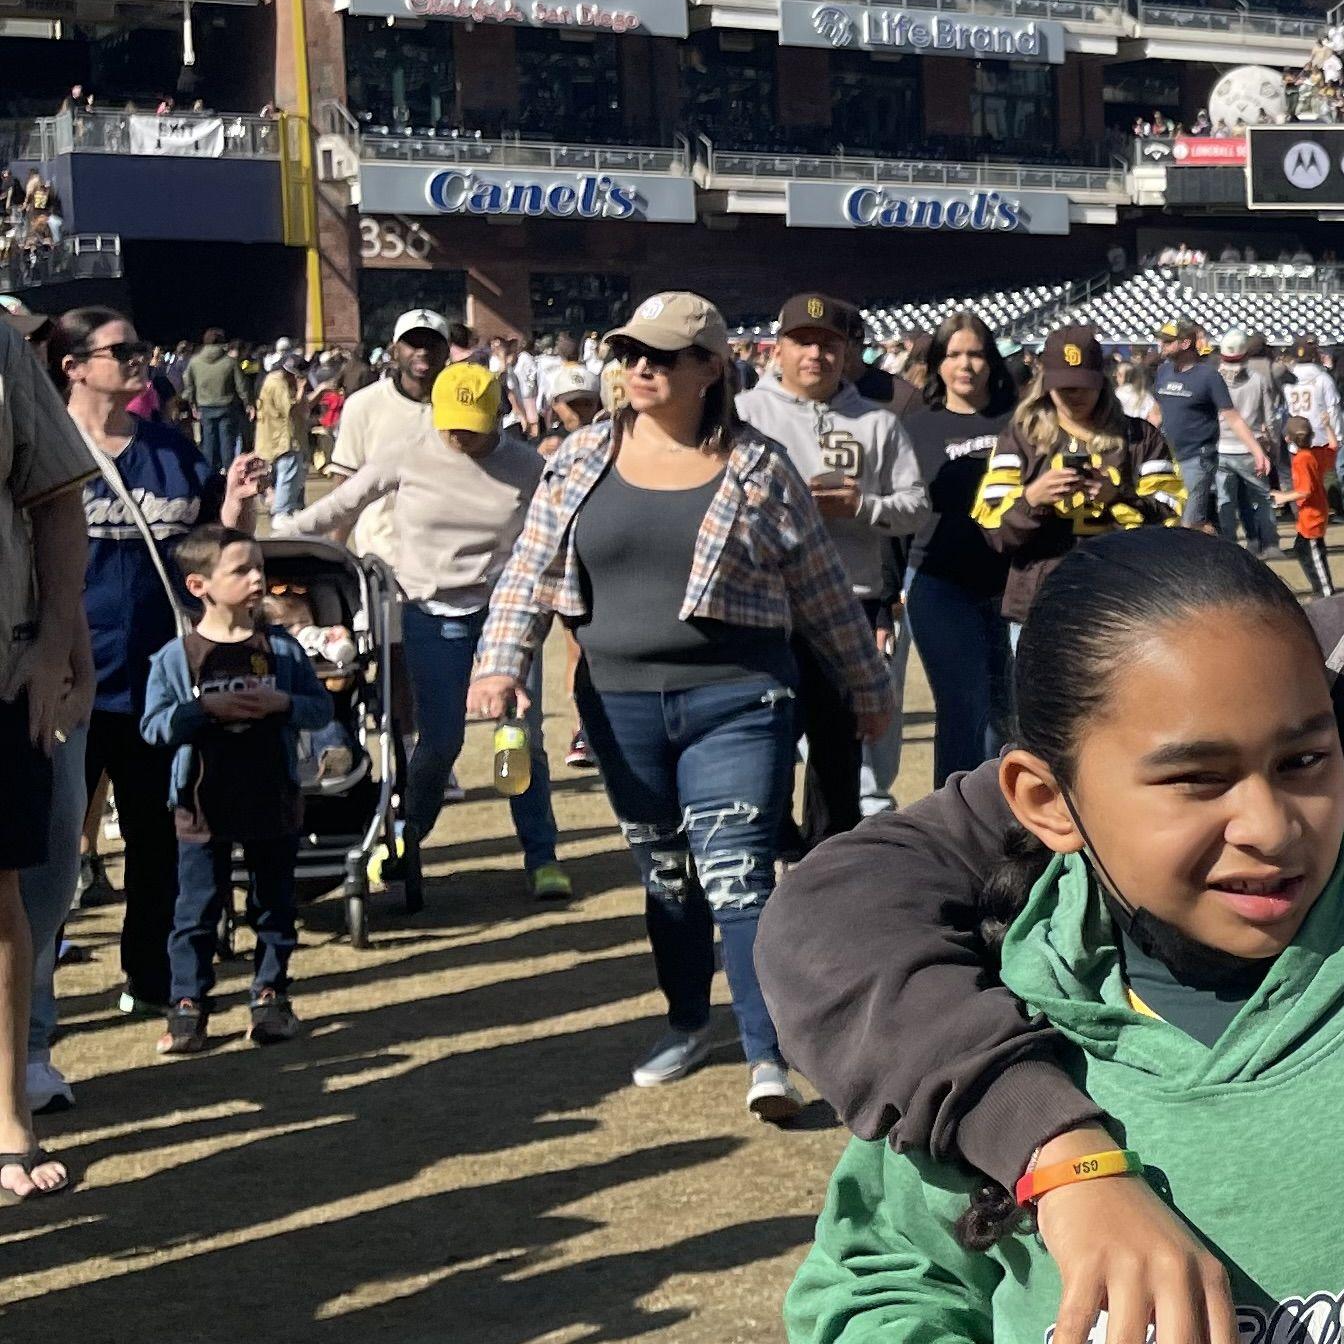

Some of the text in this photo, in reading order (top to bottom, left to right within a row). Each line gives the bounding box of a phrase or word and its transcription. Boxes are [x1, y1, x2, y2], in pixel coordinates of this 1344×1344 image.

[576, 2, 640, 33] Diego
[862, 10, 1041, 57] LifeBrand
[425, 167, 637, 220] Canel's
[843, 183, 1024, 233] Canel's
